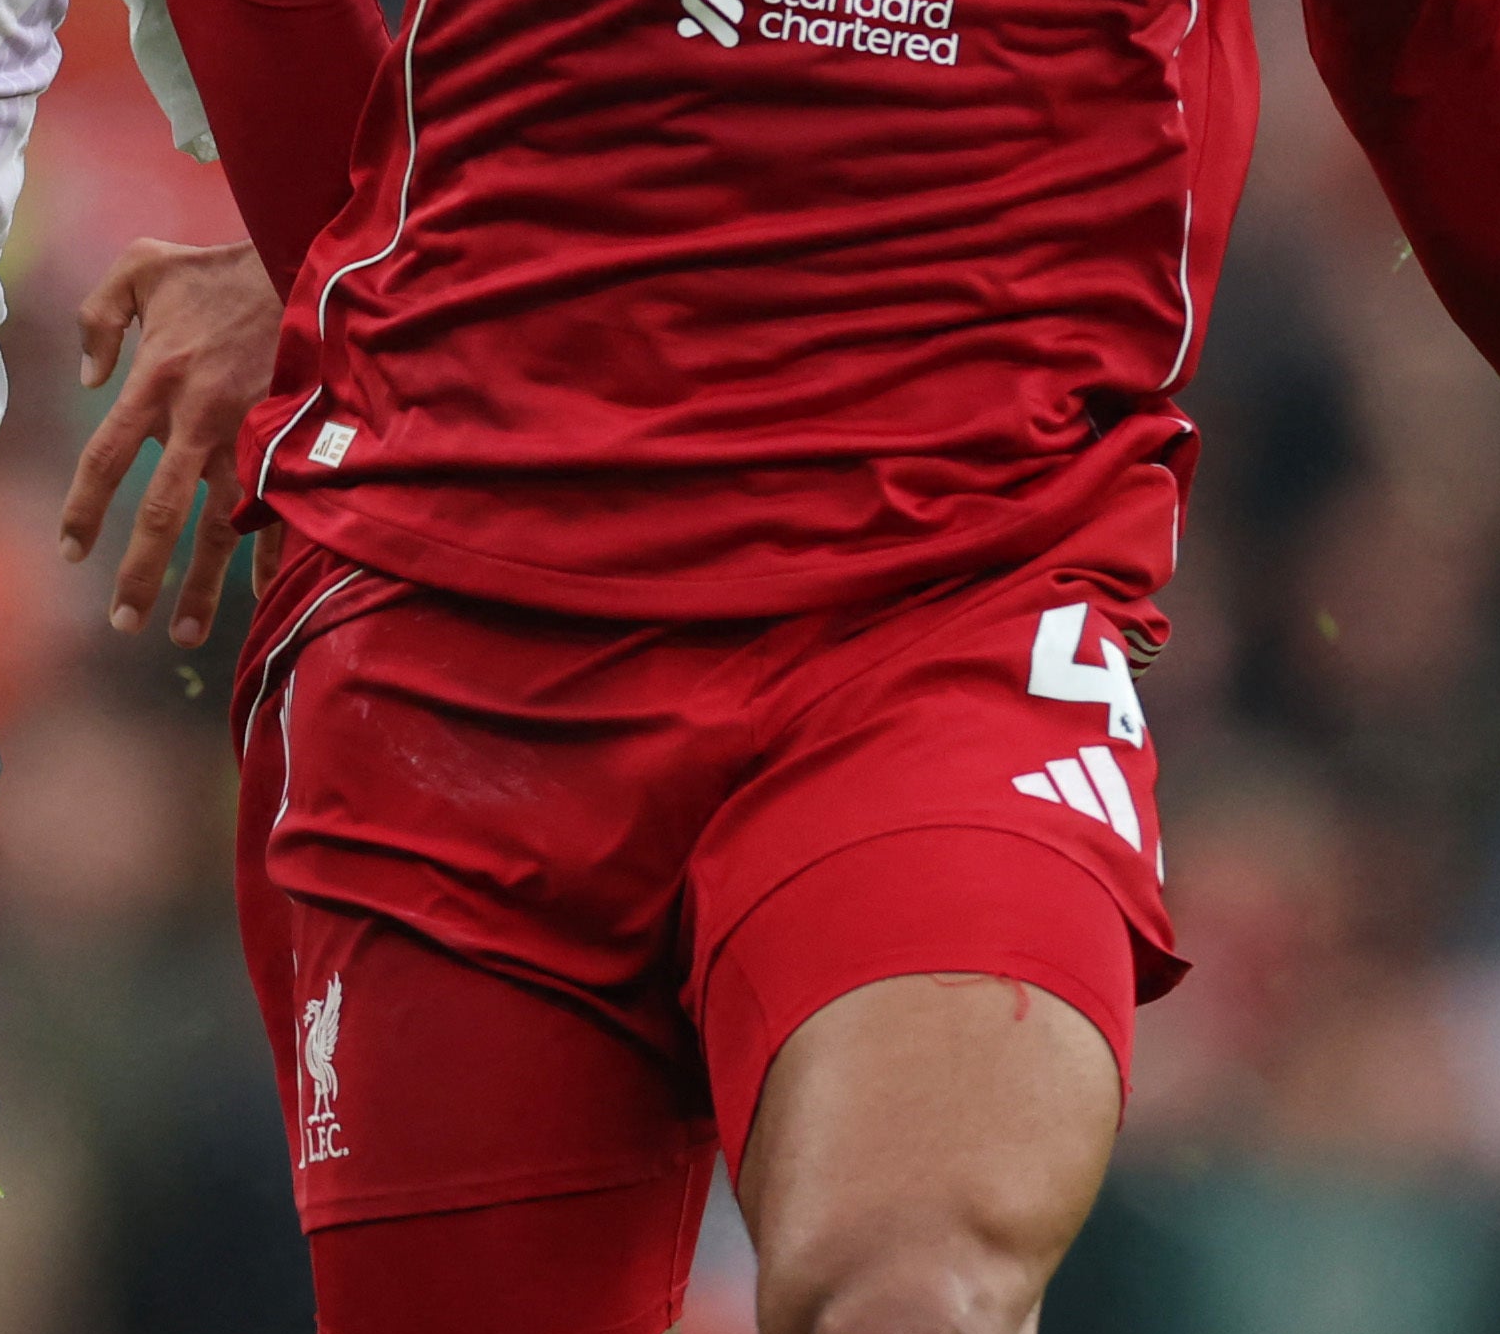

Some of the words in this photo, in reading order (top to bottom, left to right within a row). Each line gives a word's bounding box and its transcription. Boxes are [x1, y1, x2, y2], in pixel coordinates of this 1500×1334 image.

[759, 8, 959, 65] chartered
[1027, 601, 1147, 750] 4
[306, 1123, 350, 1162] L.F.C.
